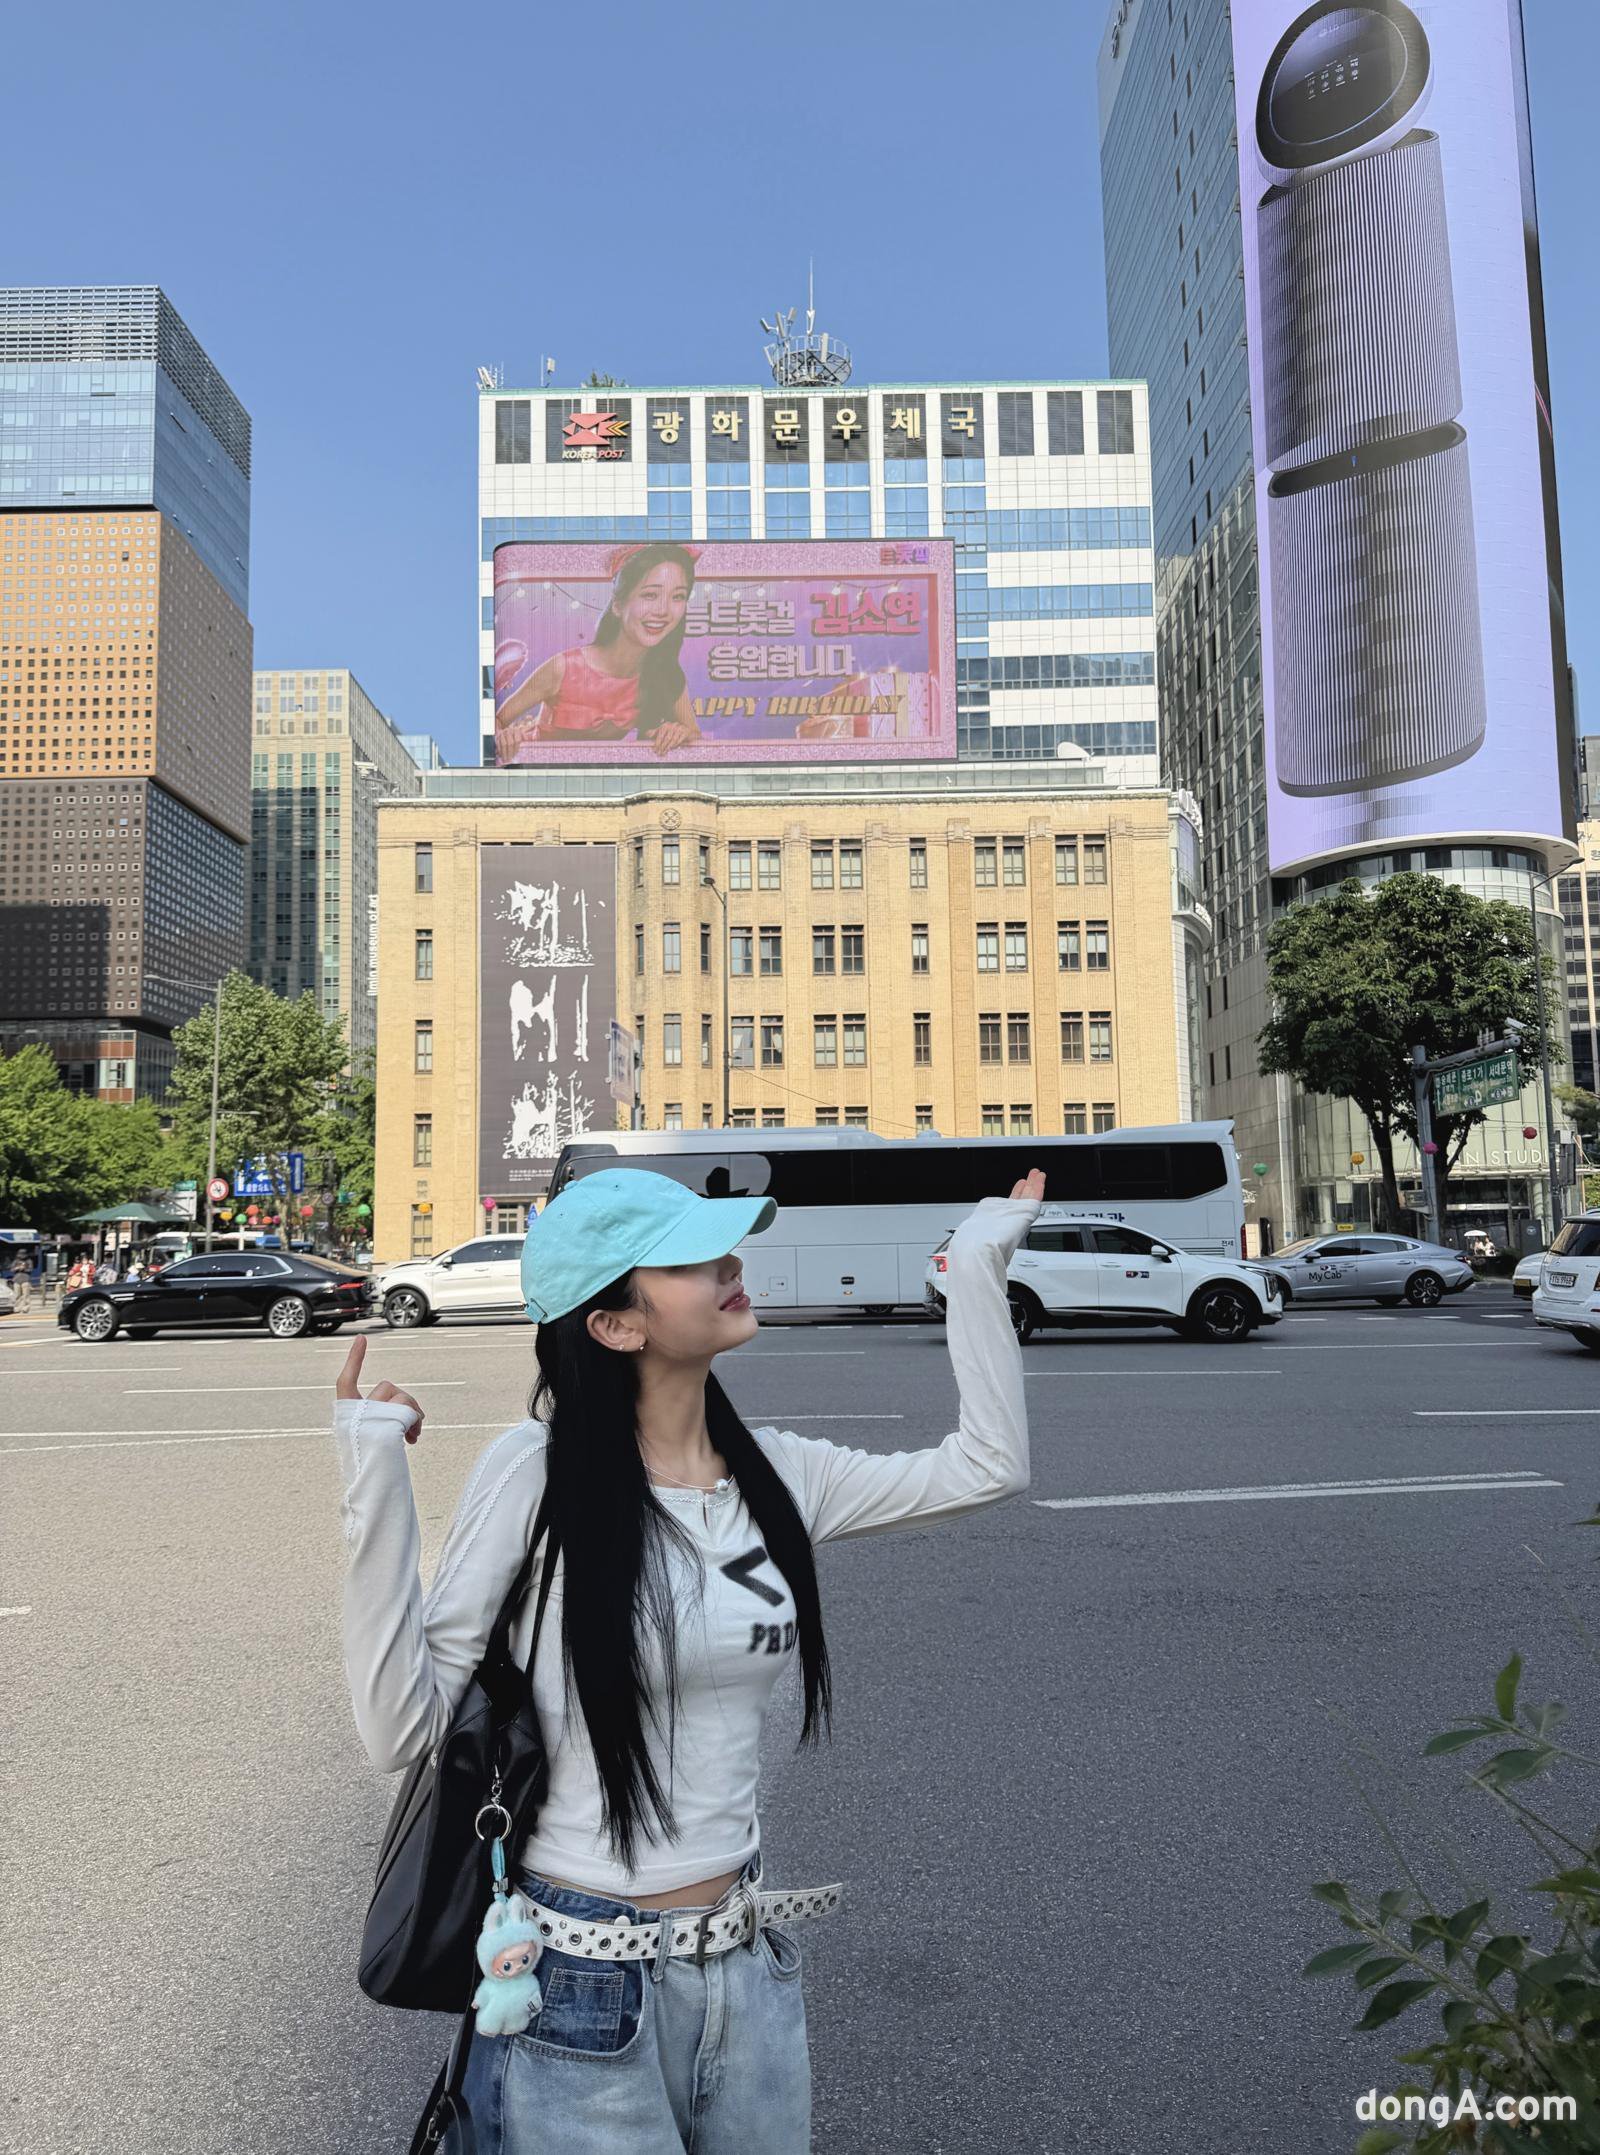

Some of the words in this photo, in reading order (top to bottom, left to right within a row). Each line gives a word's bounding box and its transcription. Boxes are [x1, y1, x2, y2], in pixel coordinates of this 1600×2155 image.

[562, 449, 597, 460] KOREA
[598, 449, 625, 460] POST
[812, 591, 921, 636] 김소연
[709, 644, 856, 680] 응원합니다
[692, 696, 761, 716] APPY
[366, 909, 378, 922] of
[367, 922, 378, 969] museum
[1489, 1059, 1514, 1078] 서대문역
[1491, 1149, 1549, 1165] STUDI
